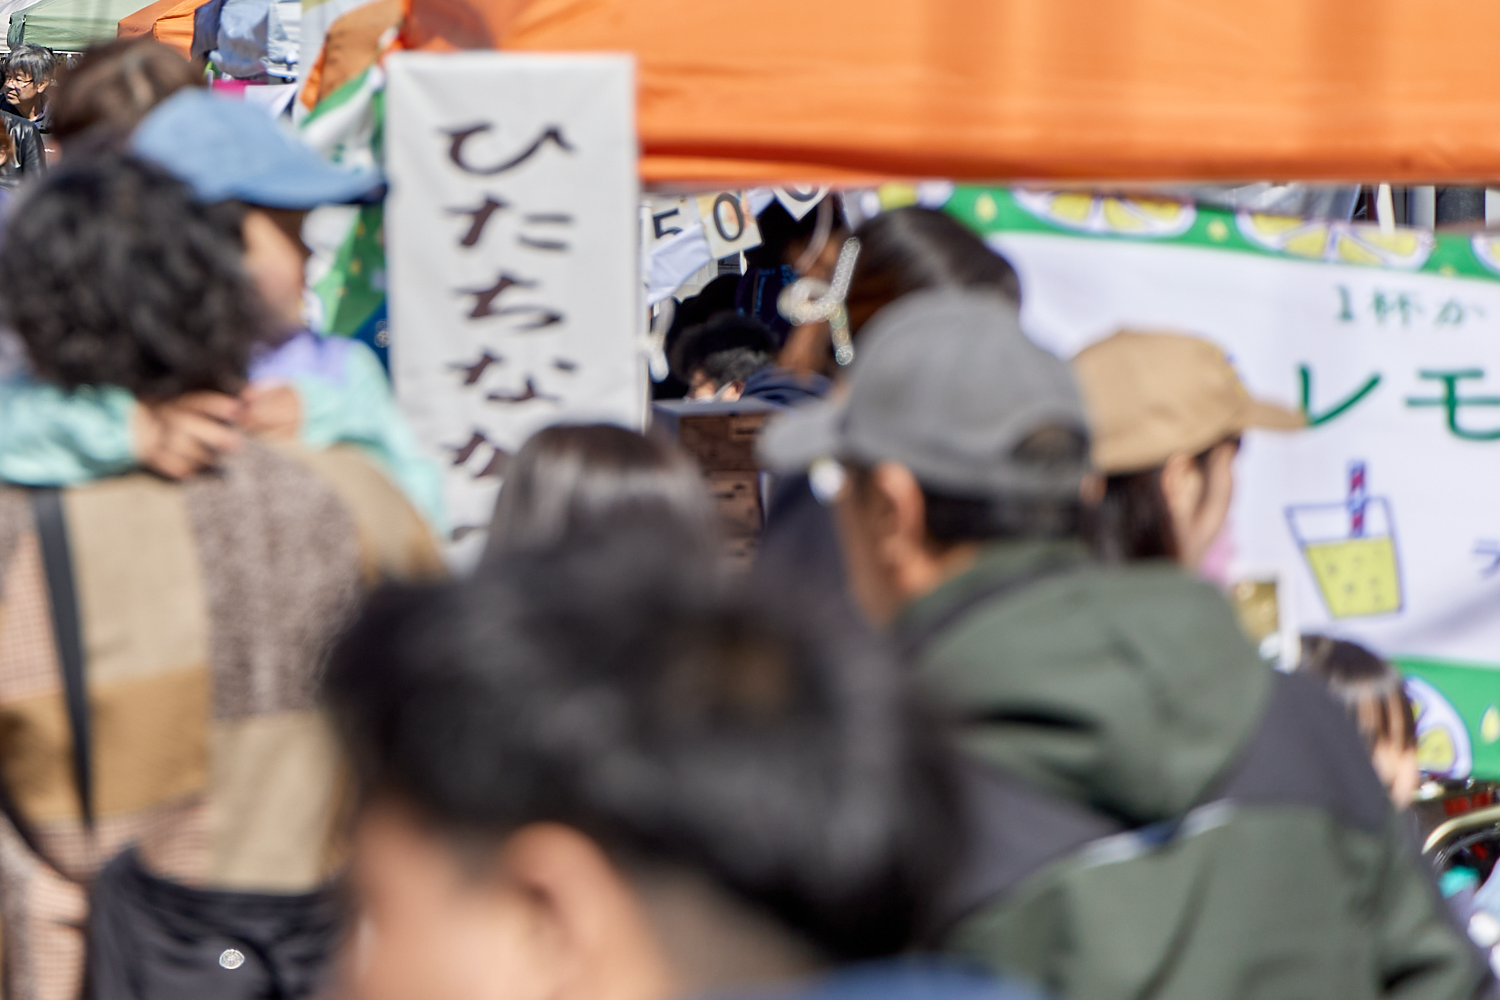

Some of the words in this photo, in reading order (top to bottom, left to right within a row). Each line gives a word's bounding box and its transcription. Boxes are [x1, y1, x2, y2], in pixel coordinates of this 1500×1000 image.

[436, 120, 577, 540] ひたちなか
[1294, 360, 1500, 442] レモ
